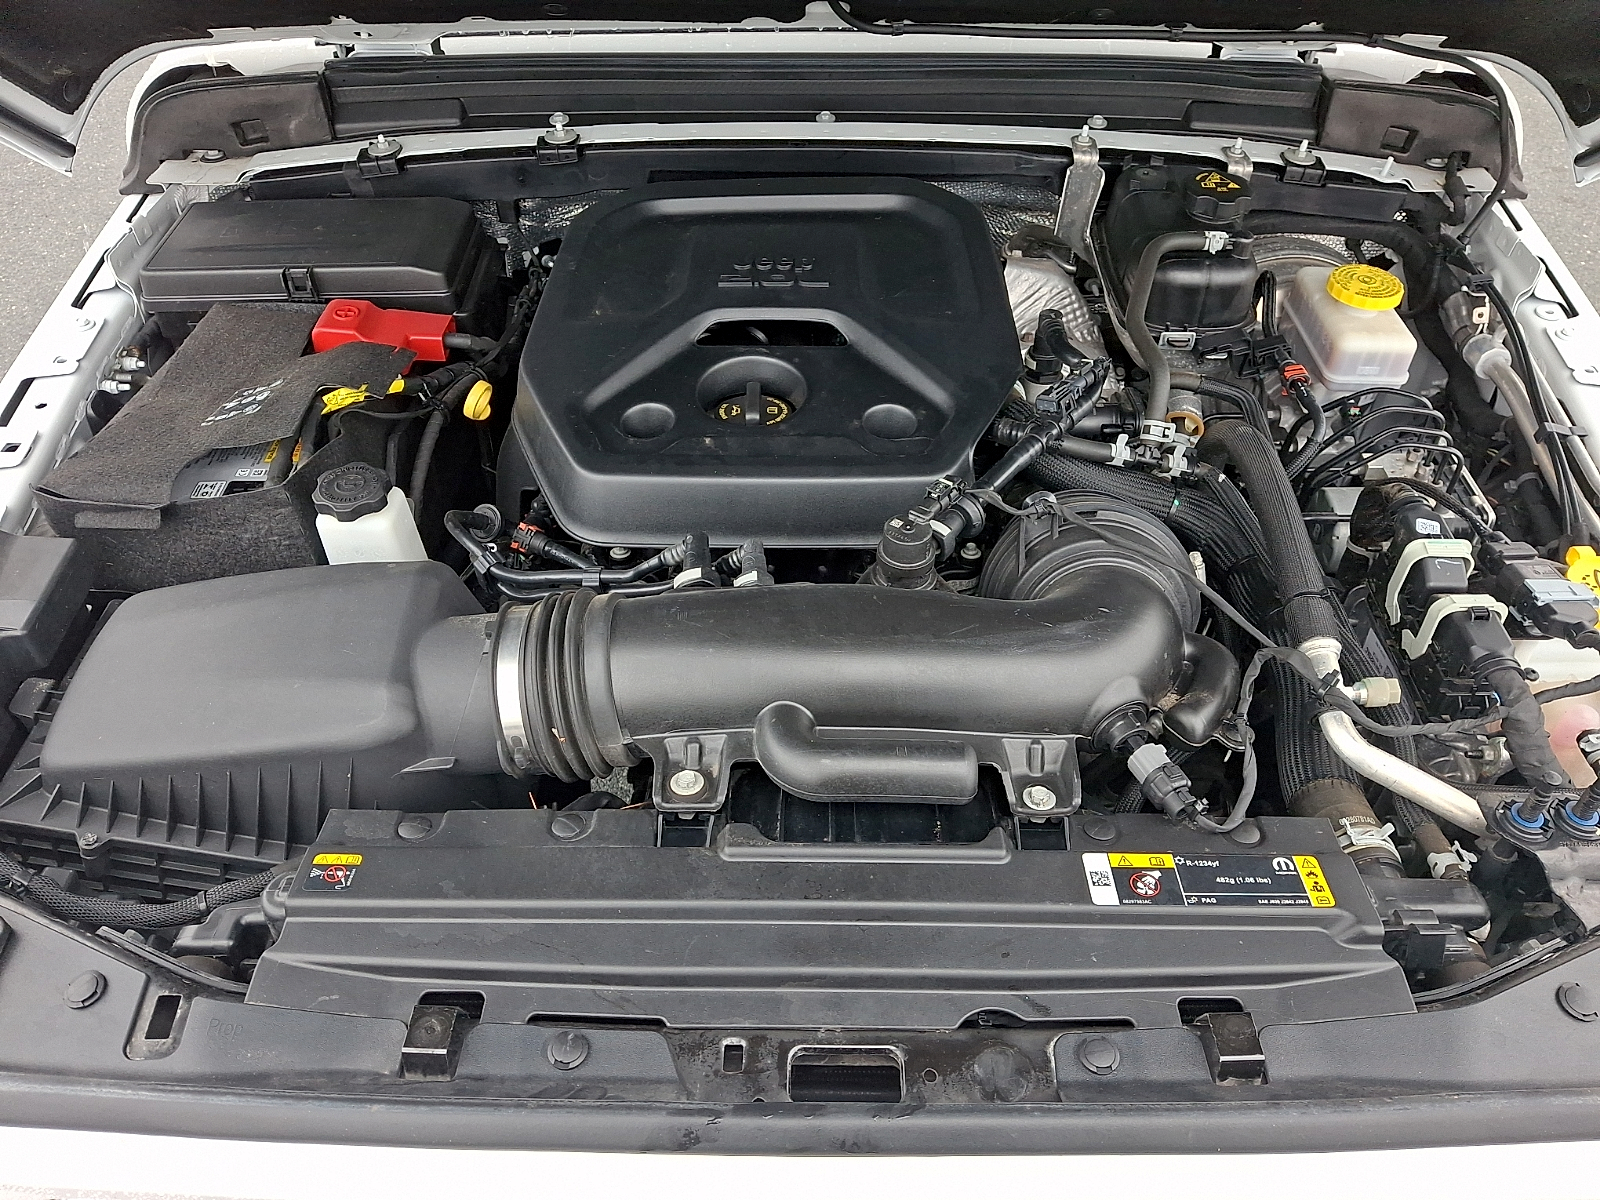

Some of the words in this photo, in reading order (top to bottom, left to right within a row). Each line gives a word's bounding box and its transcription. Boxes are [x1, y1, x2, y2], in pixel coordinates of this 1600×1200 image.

[1185, 860, 1220, 868] R-1234yf
[1215, 876, 1236, 885] 482g
[1236, 876, 1255, 885] (1.06
[1256, 877, 1272, 885] lbs)
[206, 1018, 244, 1041] Prop
